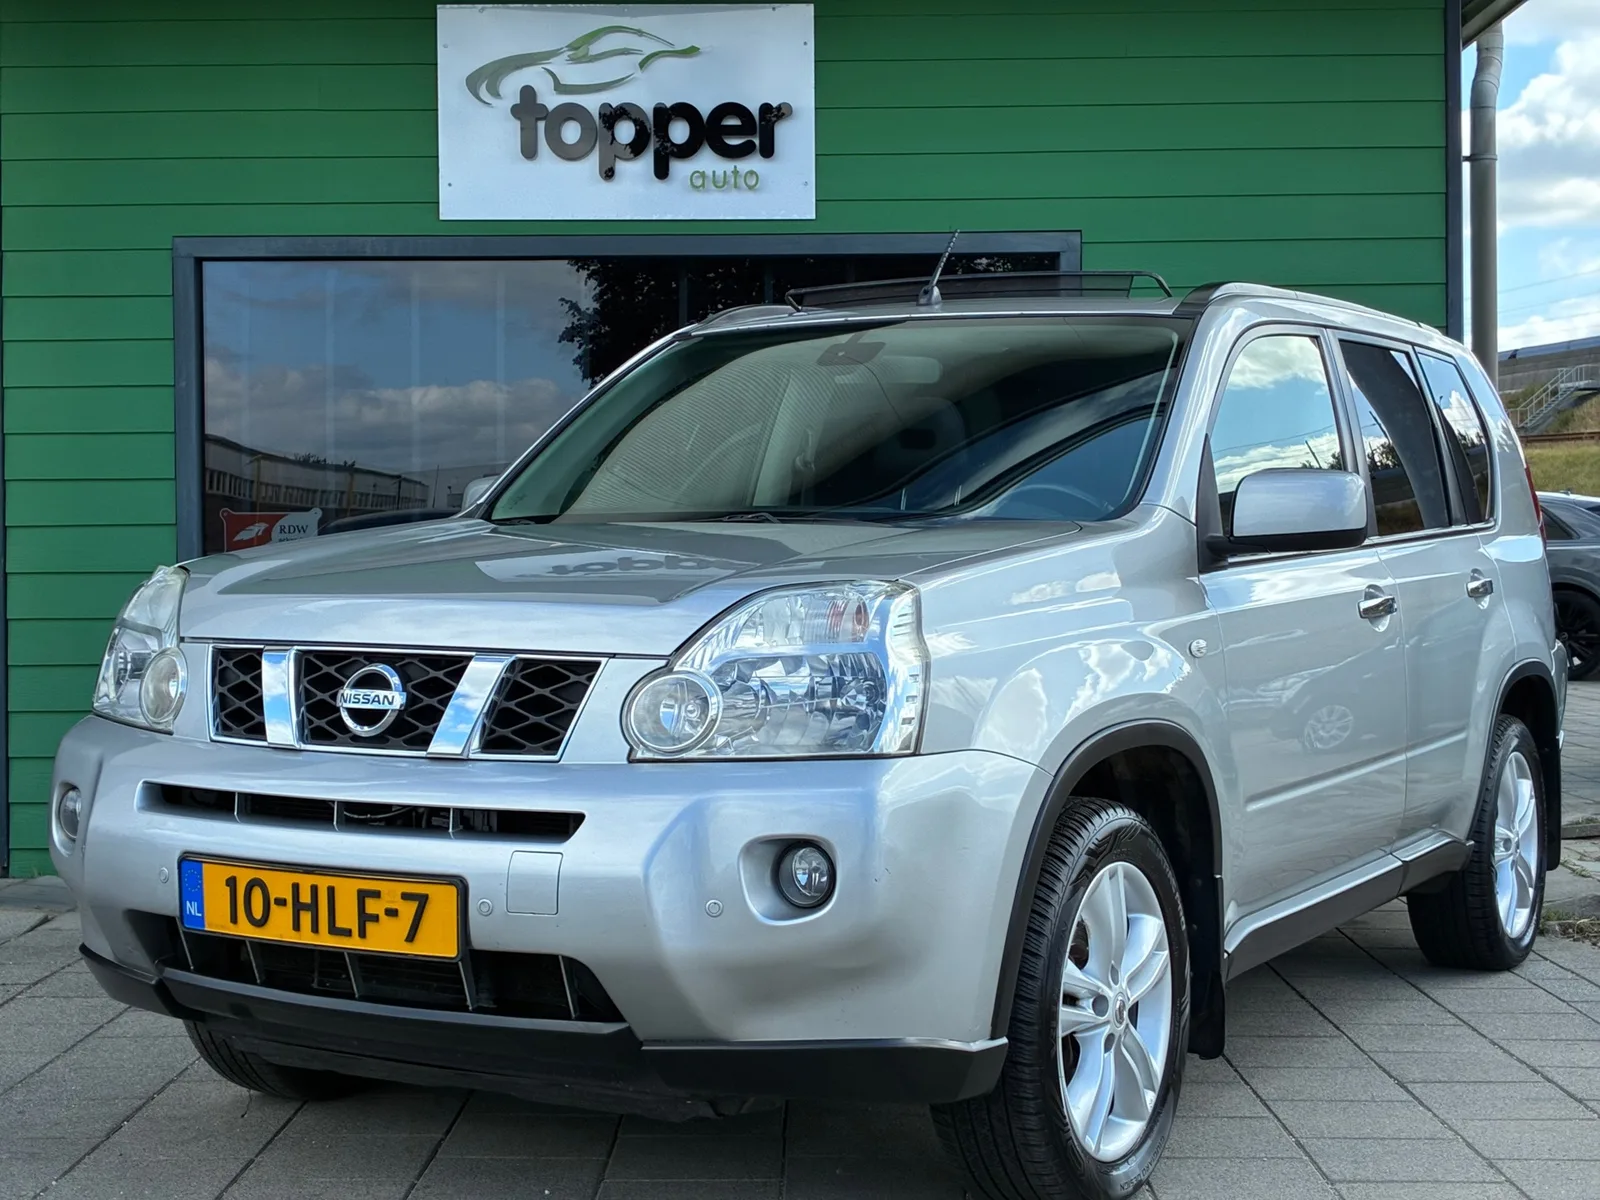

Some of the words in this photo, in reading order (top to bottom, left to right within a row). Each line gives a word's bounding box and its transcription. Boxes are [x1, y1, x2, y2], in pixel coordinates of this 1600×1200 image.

[510, 85, 793, 181] topper
[689, 165, 760, 191] auto
[279, 524, 309, 535] RDW
[340, 692, 395, 706] NISSAN
[186, 900, 202, 917] NL
[225, 875, 429, 943] 10-HLF-7
